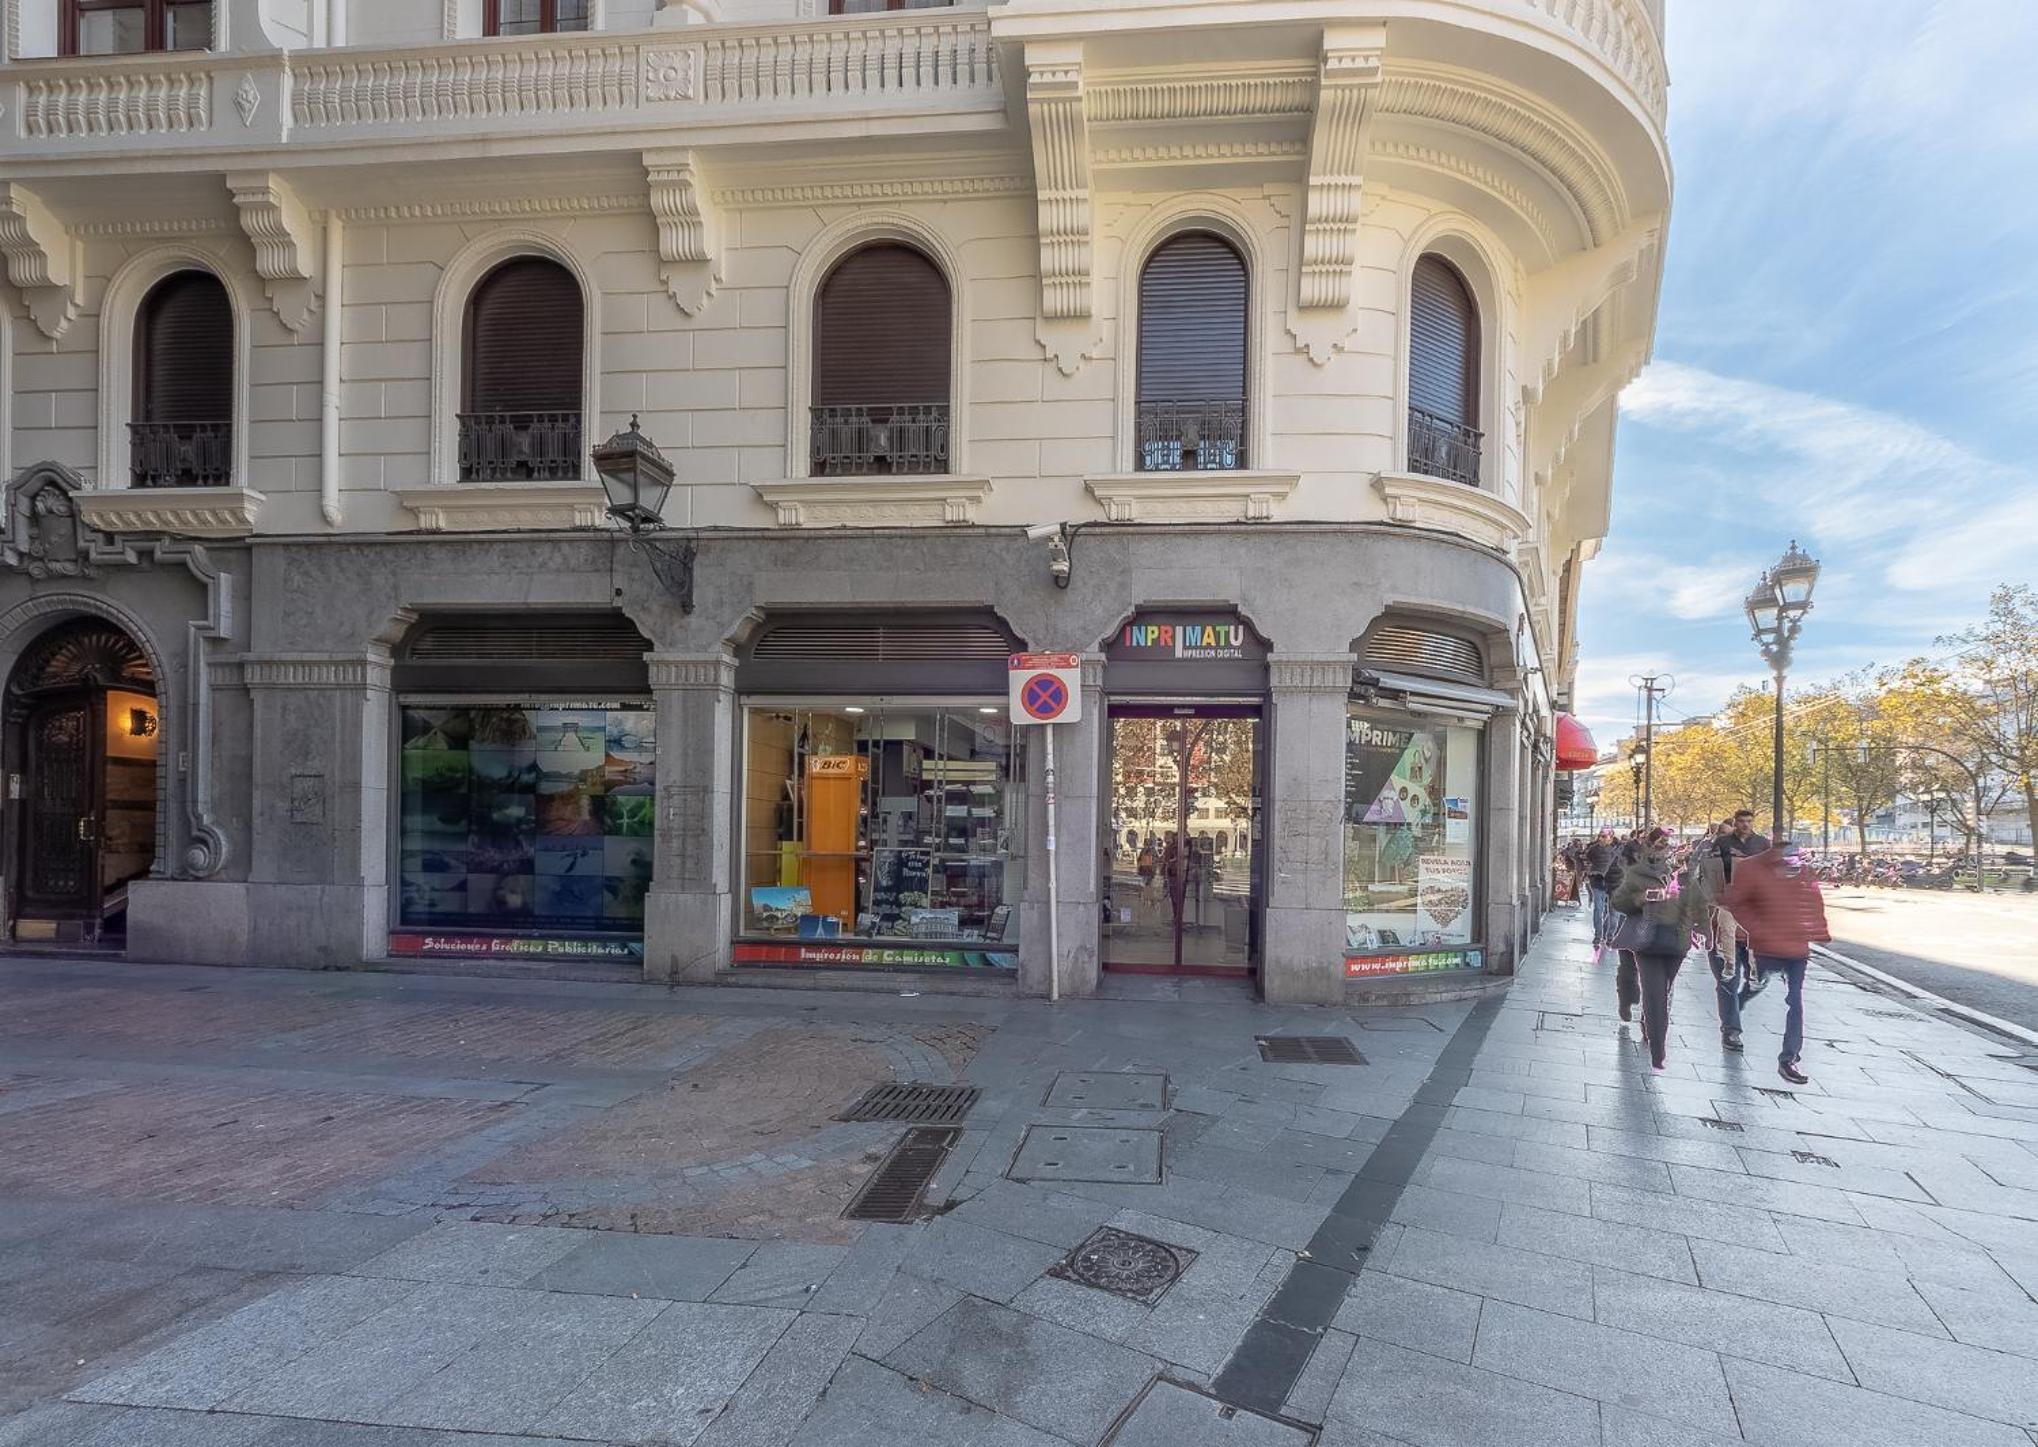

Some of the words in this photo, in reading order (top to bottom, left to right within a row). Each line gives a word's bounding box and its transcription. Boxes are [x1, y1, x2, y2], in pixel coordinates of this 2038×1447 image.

[1125, 625, 1244, 658] INPRIMATU
[1217, 649, 1242, 658] DIGITAL
[821, 760, 847, 770] BIC
[422, 937, 488, 951] Soluciones
[546, 941, 629, 955] Publicitarias
[863, 948, 879, 962] de
[882, 950, 950, 963] Camisetas
